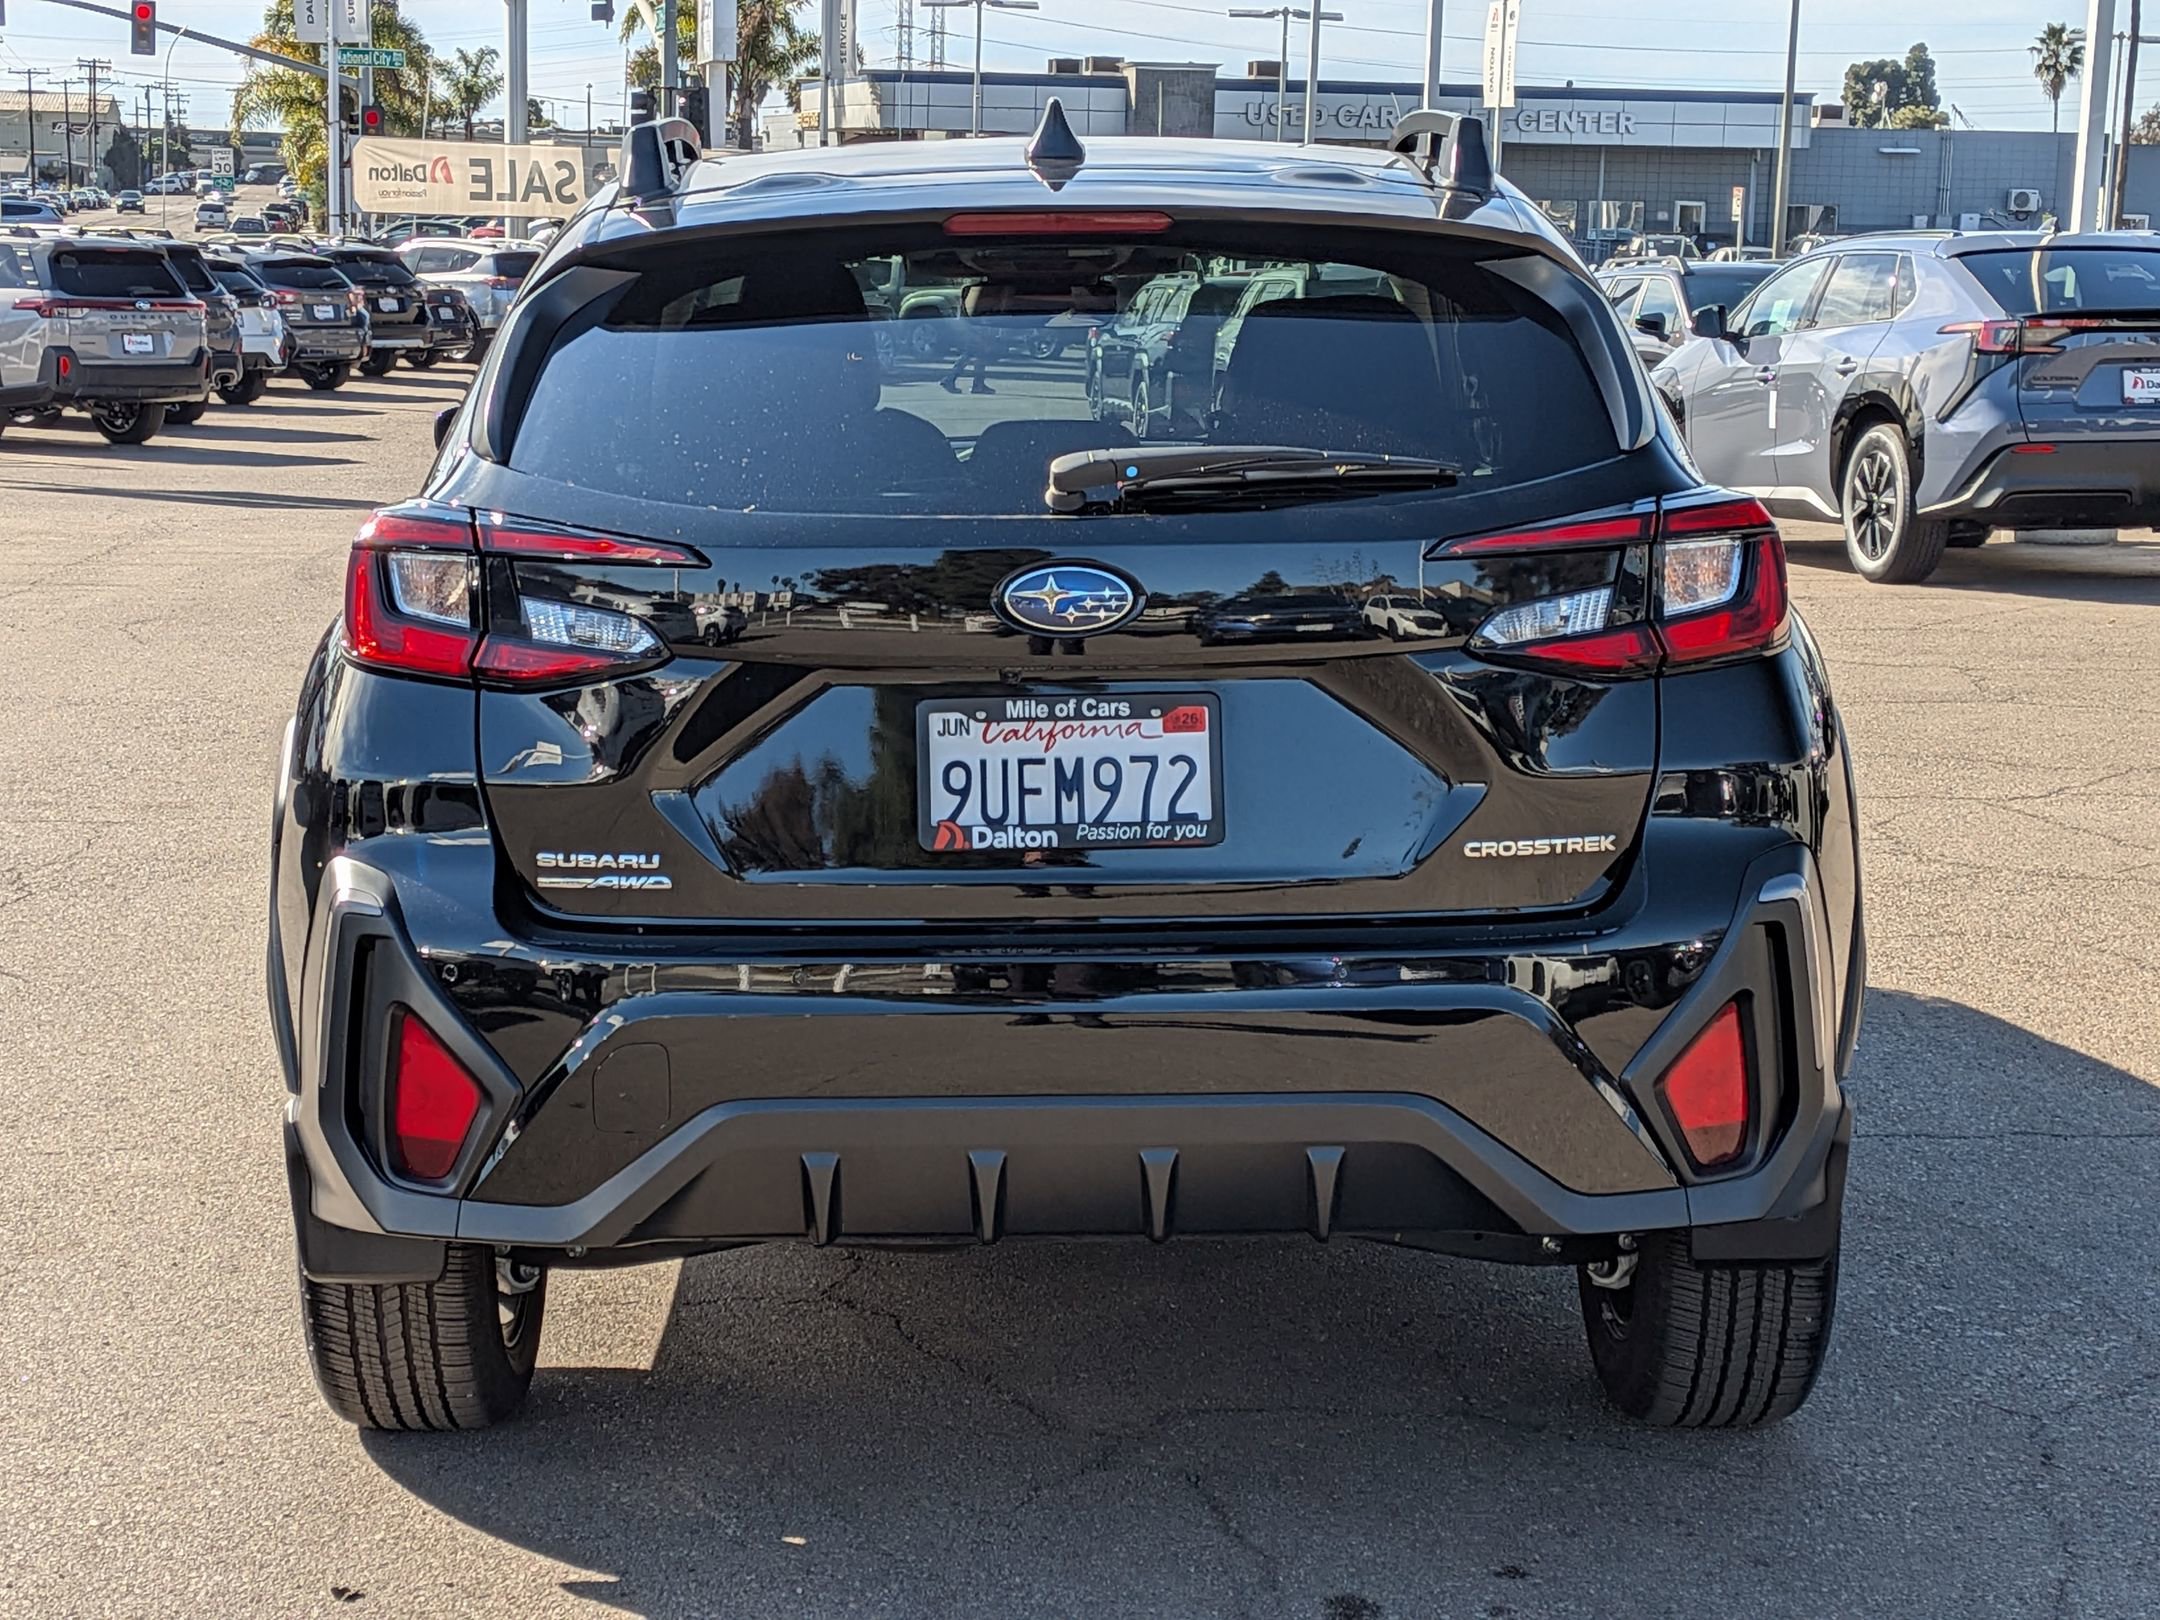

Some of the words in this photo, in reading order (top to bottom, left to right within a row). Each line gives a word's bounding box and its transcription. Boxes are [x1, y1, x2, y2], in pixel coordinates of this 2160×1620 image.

[373, 51, 392, 66] City
[1516, 109, 1638, 135] CENTER
[214, 163, 232, 173] 30
[1005, 700, 1049, 719] Mile
[1054, 699, 1078, 718] of
[1081, 698, 1131, 718] Cars
[1181, 712, 1199, 725] 26
[937, 717, 970, 737] JUN
[981, 720, 1164, 753] California
[942, 754, 1200, 826] 9UFM972
[971, 826, 1059, 850] Dalton
[1076, 823, 1141, 841] Passion
[1146, 822, 1167, 839] for
[1168, 823, 1207, 840] you
[1463, 834, 1617, 858] CROSSTREK
[536, 852, 660, 869] SUBARU
[586, 876, 673, 889] AWD
